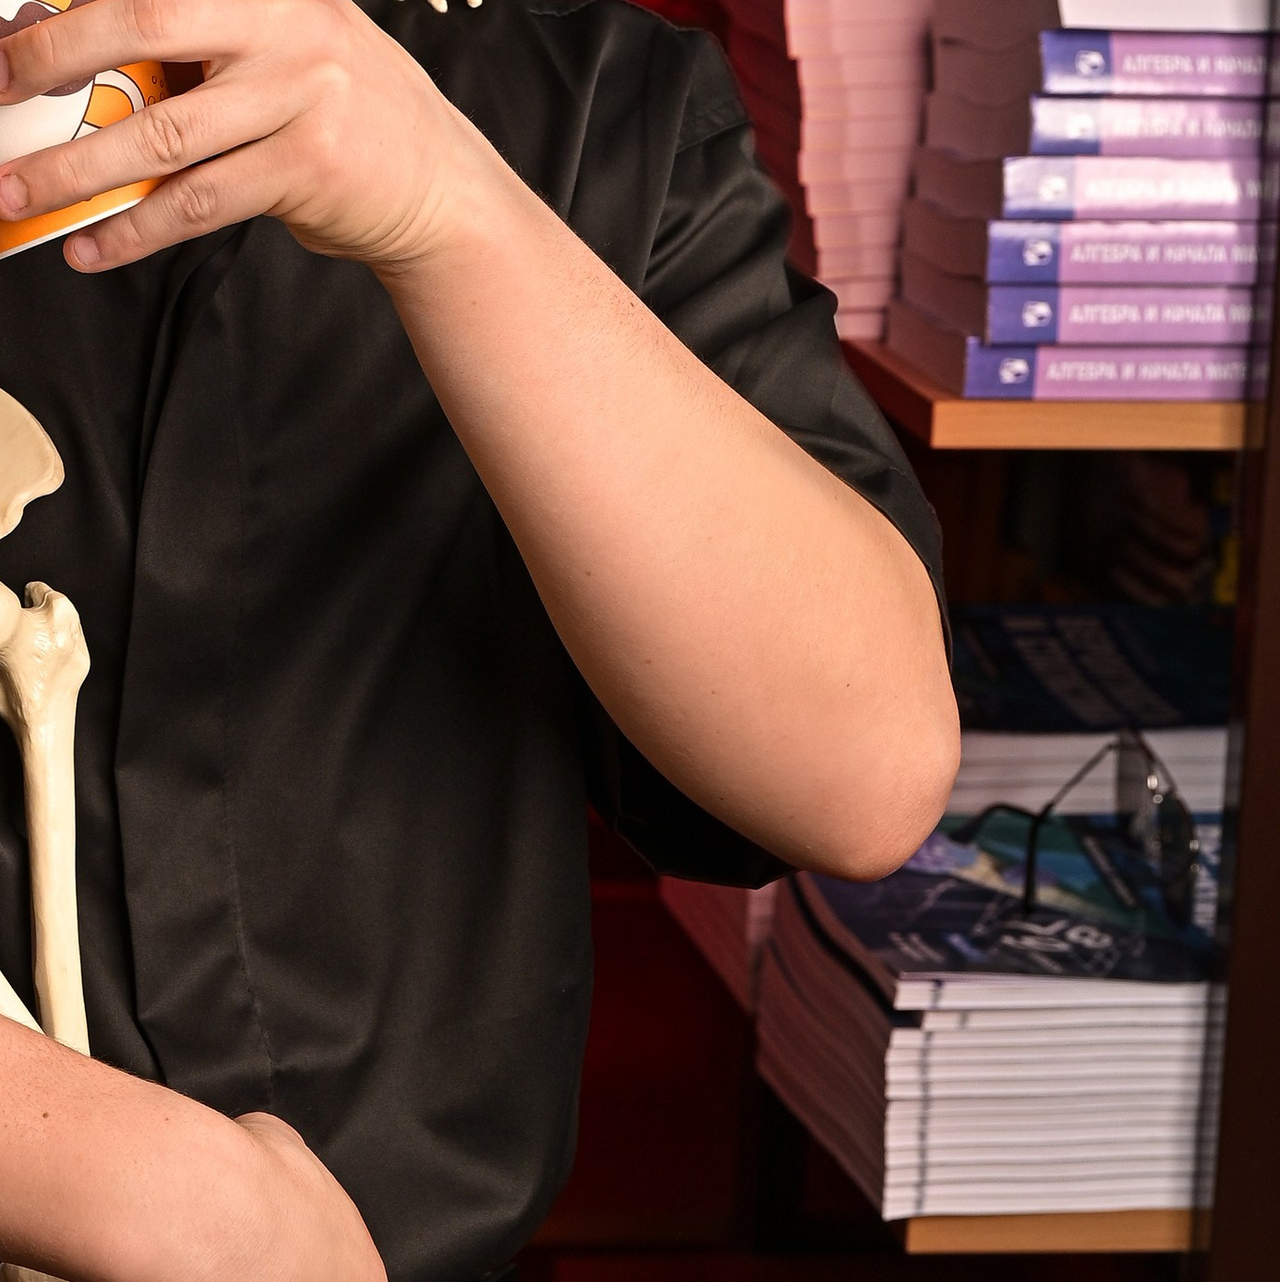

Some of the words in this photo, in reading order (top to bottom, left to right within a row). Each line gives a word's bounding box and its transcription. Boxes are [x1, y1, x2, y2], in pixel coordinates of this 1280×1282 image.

[1121, 53, 1194, 76] АЛГЕБРА
[1070, 243, 1143, 264] АЛГЕБРА
[1144, 244, 1161, 263] И
[1163, 244, 1228, 264] НАЧАЛА
[1070, 303, 1141, 324] АЛГЕБРА
[1143, 304, 1159, 323] И
[1161, 304, 1226, 324] НАЧАЛА
[1045, 360, 1118, 381] АЛГЕБРА
[1120, 361, 1136, 380] И
[1137, 361, 1202, 381] НАЧАЛА
